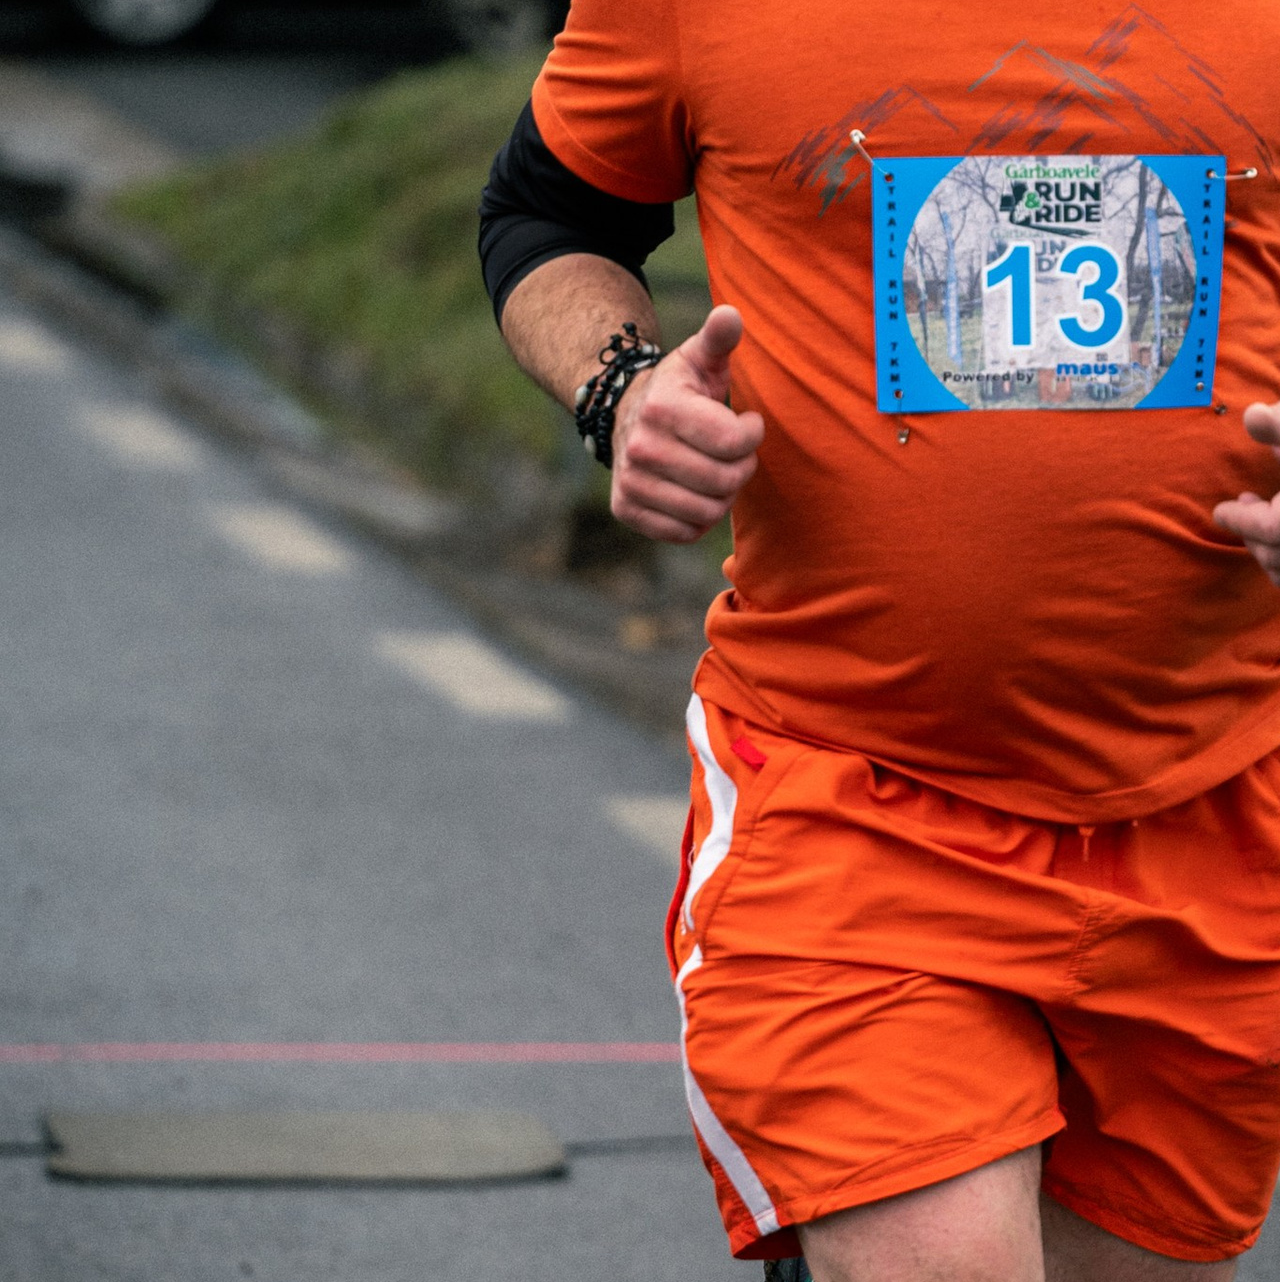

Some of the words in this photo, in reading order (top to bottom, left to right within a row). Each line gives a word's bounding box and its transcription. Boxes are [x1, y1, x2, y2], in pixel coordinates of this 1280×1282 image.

[1035, 181, 1102, 202] RUN
[888, 185, 897, 258] TRAIL
[1035, 204, 1102, 223] RIDE
[1202, 183, 1211, 256] TRAIL
[889, 280, 898, 320] RUN
[985, 243, 1125, 349] 13
[1200, 276, 1209, 317] RUN
[890, 343, 900, 383] 7KM
[943, 370, 1011, 383] Powered
[1017, 369, 1035, 385] by
[1056, 362, 1119, 375] maus
